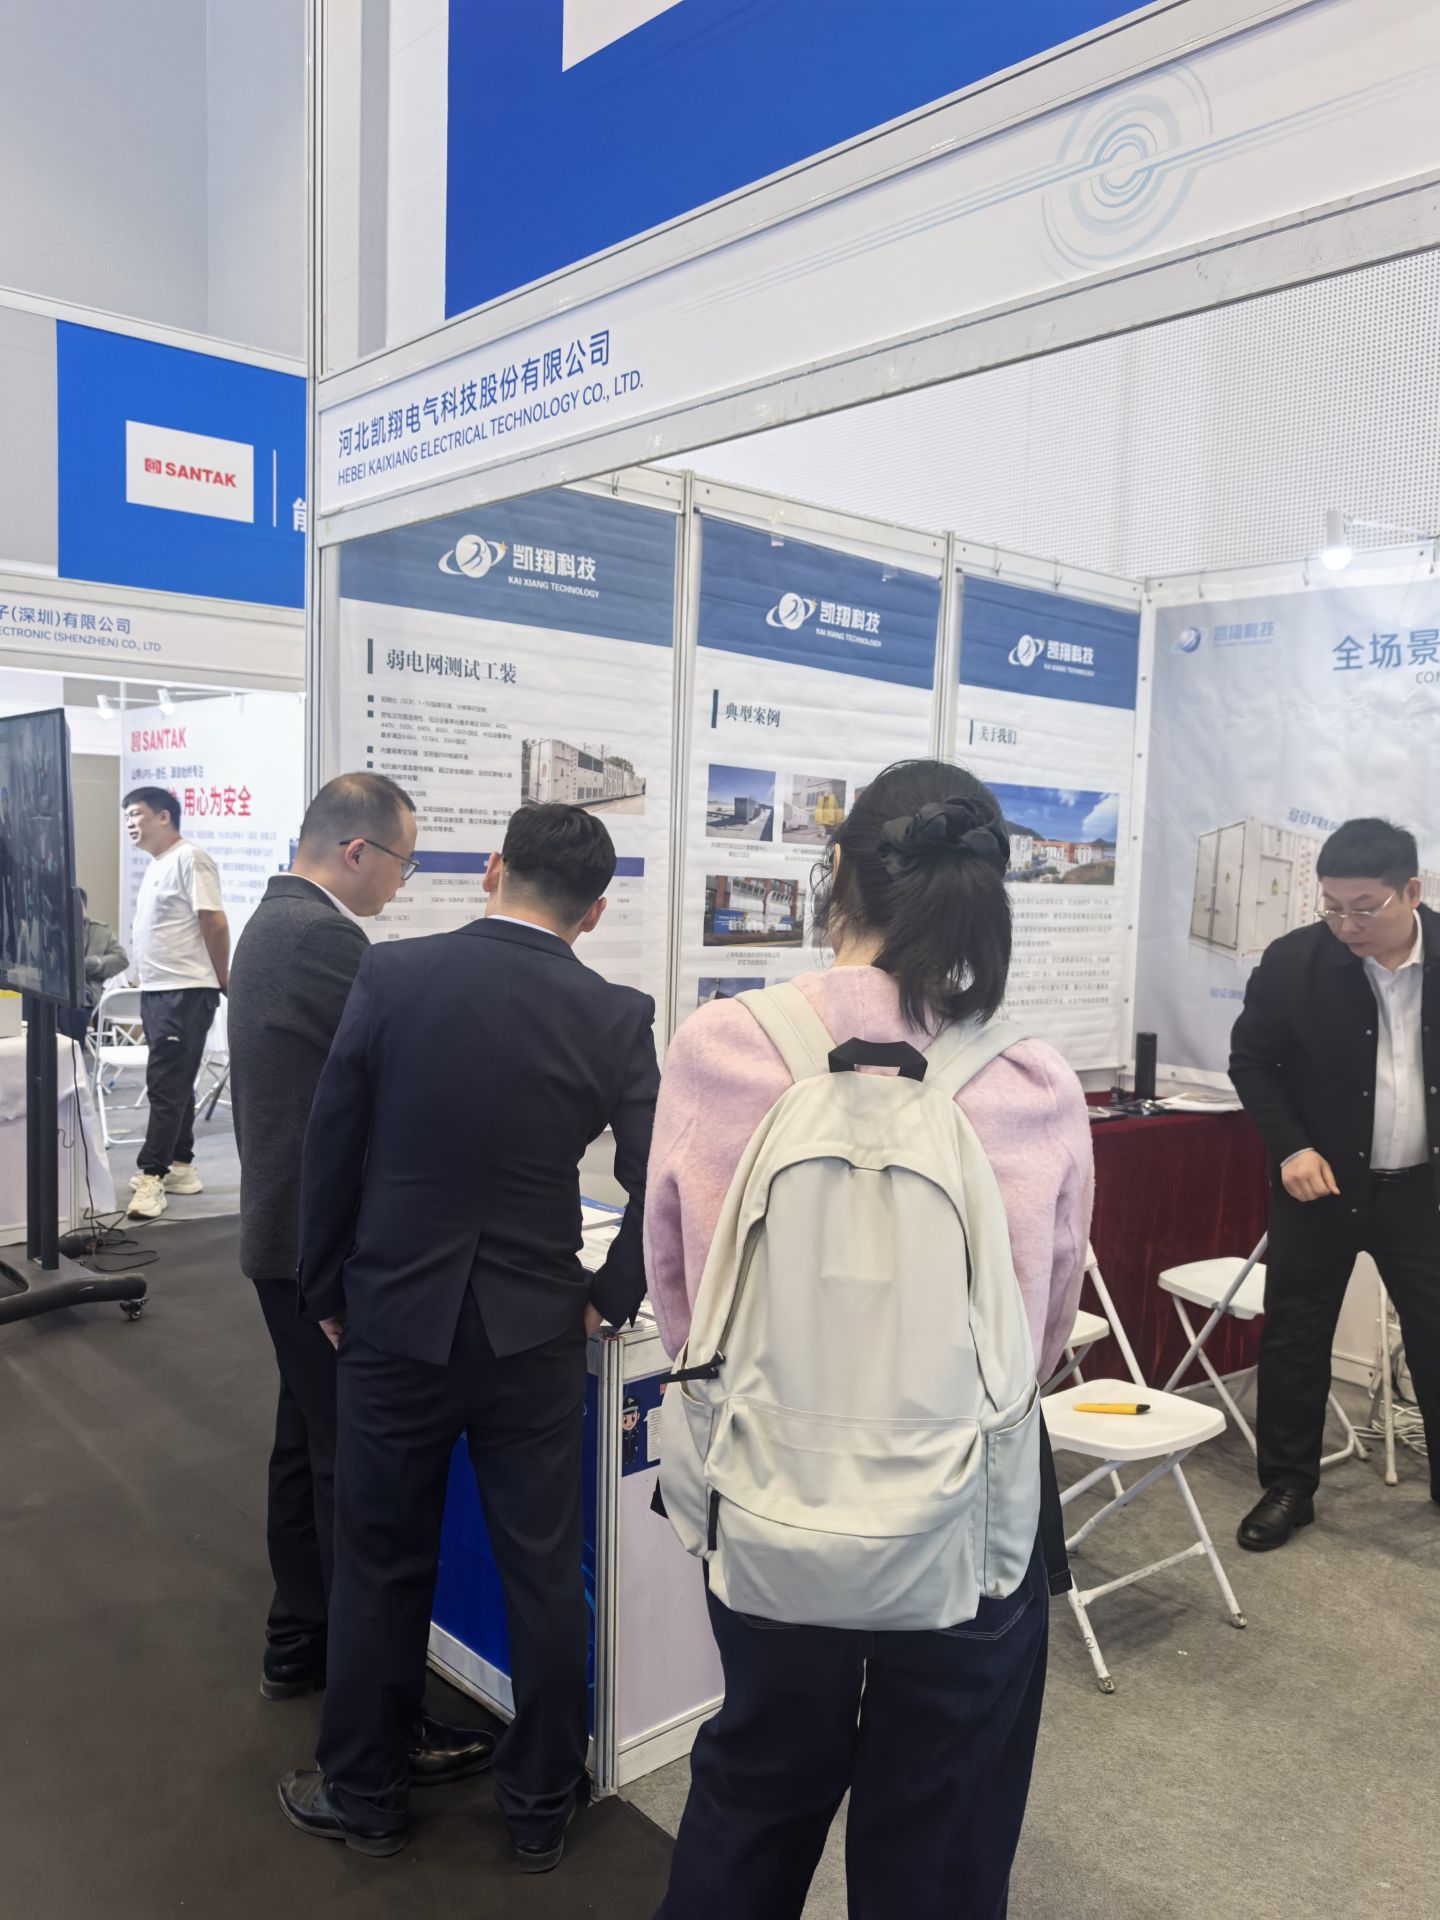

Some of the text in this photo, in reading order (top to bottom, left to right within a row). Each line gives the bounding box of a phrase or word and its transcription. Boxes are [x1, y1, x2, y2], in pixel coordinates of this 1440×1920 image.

[338, 329, 610, 458] 河北凯翔电气科技股份有限公司
[338, 370, 644, 486] HEBEI KAIXIANG ELECTRICAL TECHNOLOGY CO., LTD.
[165, 462, 237, 488] SANTAK
[513, 543, 597, 582] 凯翔科技
[508, 576, 600, 599] KAI XIANG TECHNOLOGY
[820, 600, 881, 634] 凯翔科技
[54, 631, 119, 648] (SHENZHEN)
[1046, 639, 1094, 666] 凯翔科技
[1332, 628, 1440, 671] 全场景
[386, 648, 518, 684] 弱电网测试工装
[725, 702, 781, 728] 典型案例
[142, 727, 187, 749] SANTAK
[979, 725, 1018, 746] 关于我们
[184, 785, 252, 817] 用心为安全
